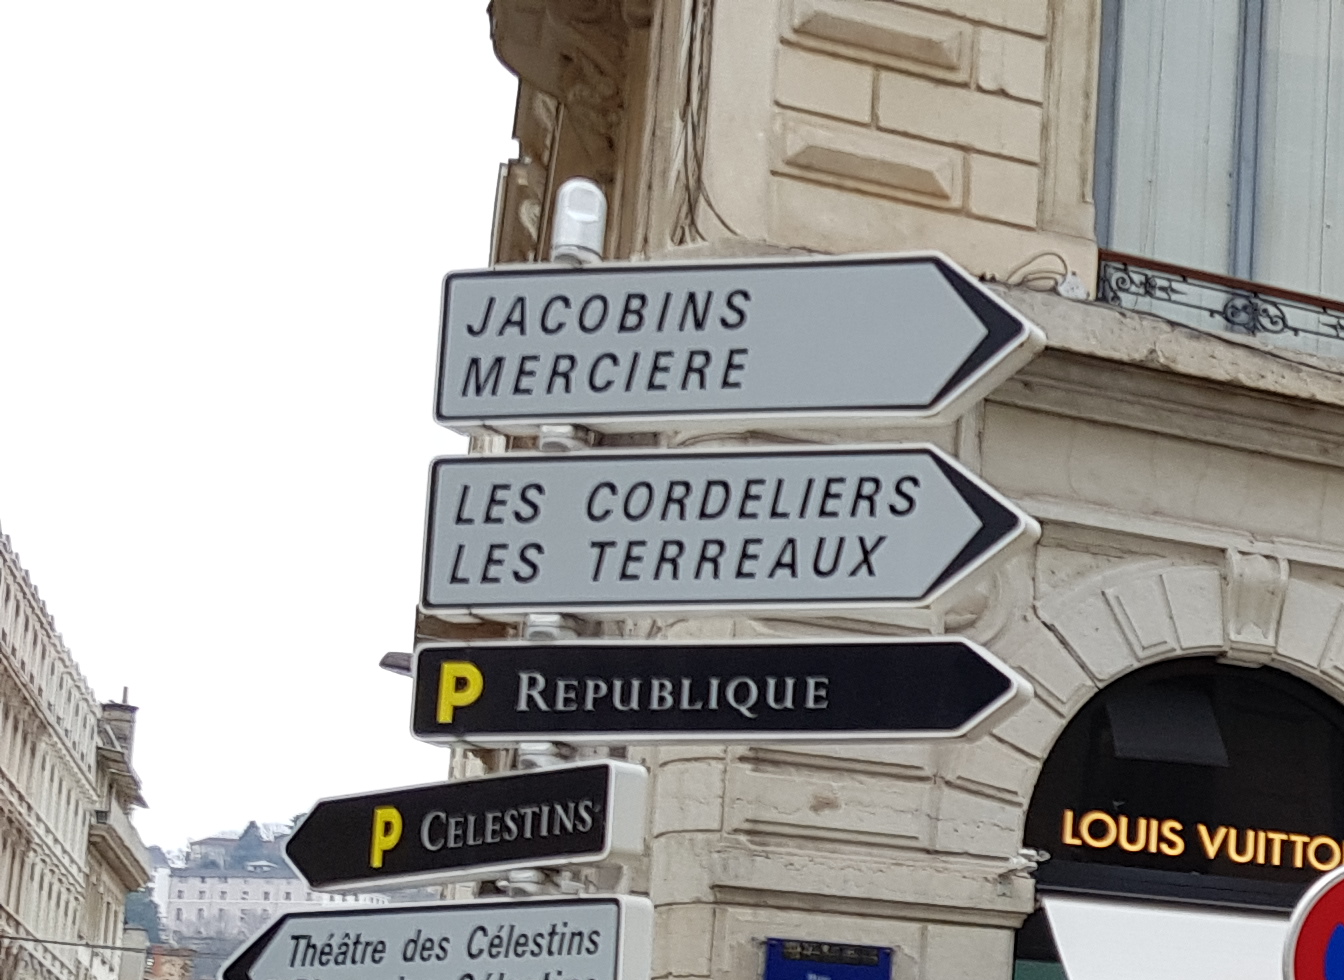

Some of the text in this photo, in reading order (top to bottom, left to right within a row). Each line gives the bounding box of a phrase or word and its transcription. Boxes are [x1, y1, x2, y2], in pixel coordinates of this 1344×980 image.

[465, 289, 753, 338] JACOBINS
[461, 348, 749, 397] MERCIERE
[455, 475, 921, 525] LES CORDELIERS
[449, 534, 887, 585] LES TERREAUX
[437, 661, 484, 724] P
[369, 804, 404, 868] P
[1061, 808, 1185, 857] LOUIS
[289, 921, 602, 968] Théâtre des Célestins
